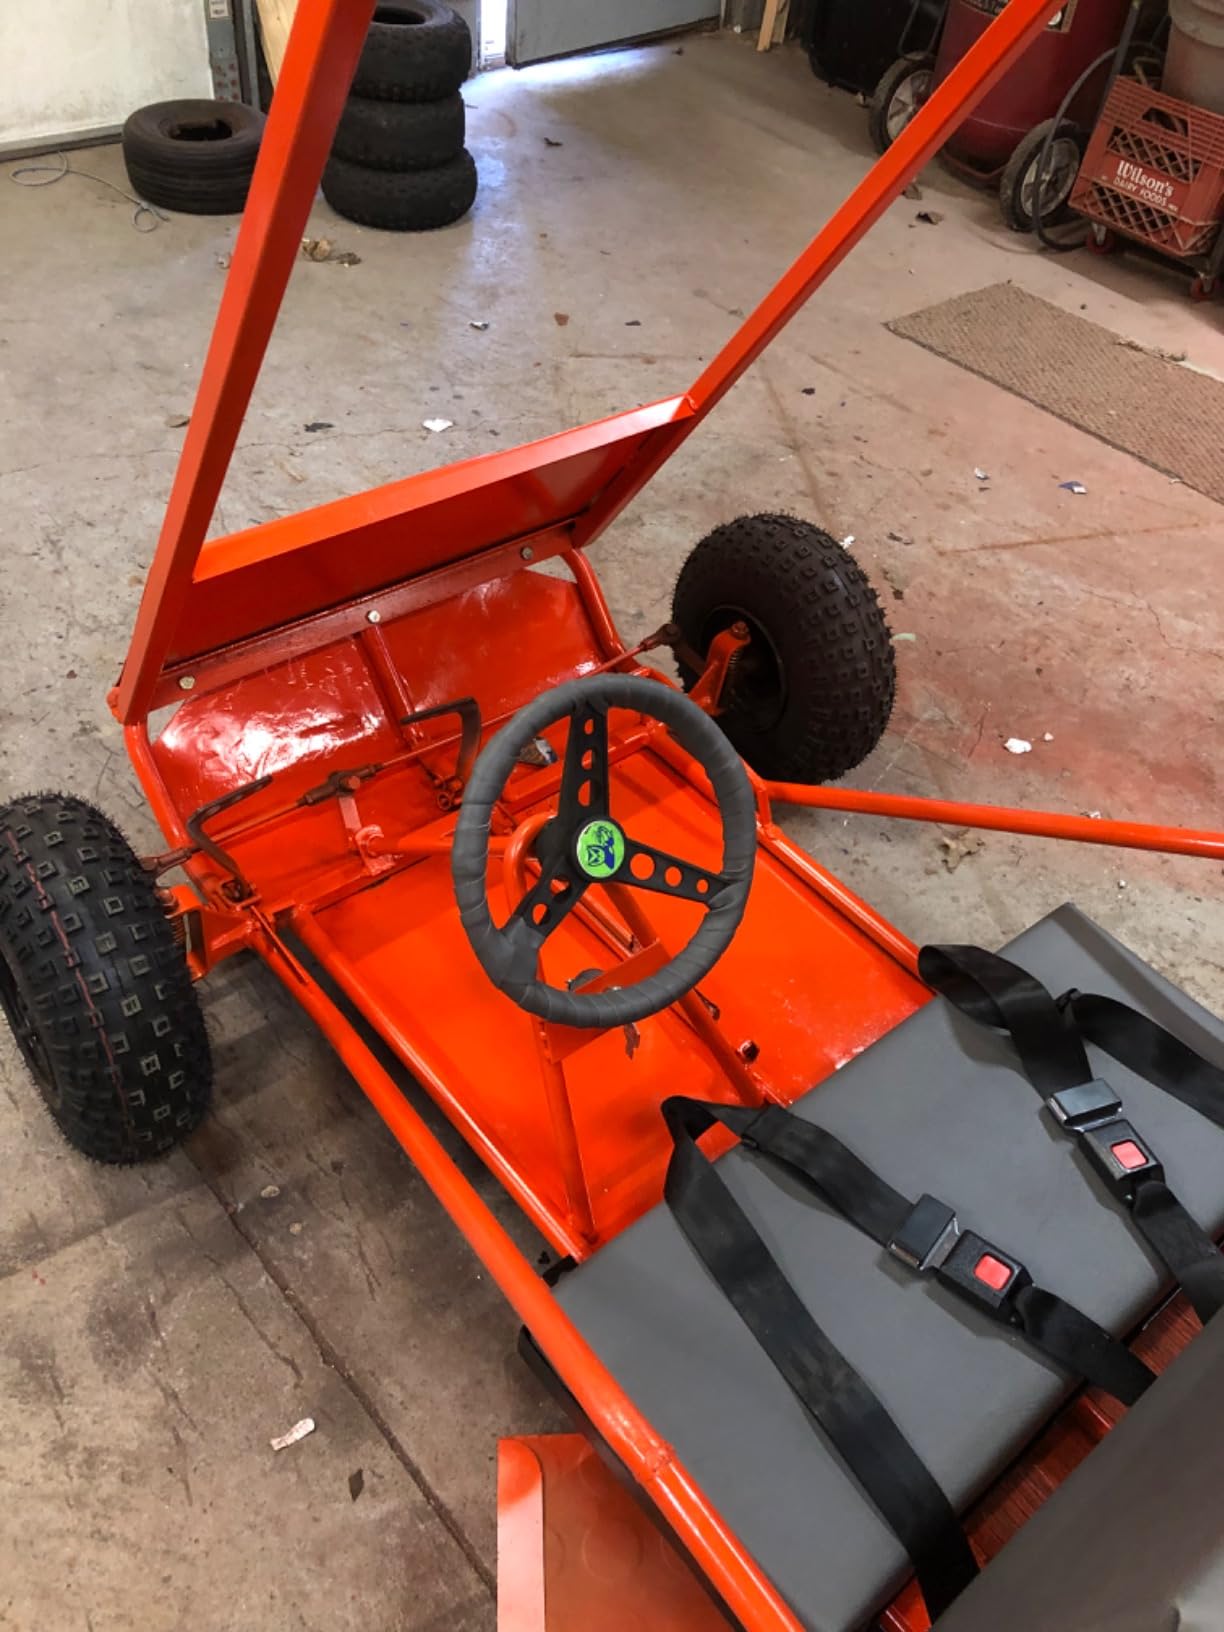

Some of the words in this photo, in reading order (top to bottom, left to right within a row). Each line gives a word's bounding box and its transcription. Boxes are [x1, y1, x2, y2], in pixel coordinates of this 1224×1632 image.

[1113, 176, 1137, 192] DAIRY
[1140, 189, 1167, 206] FOODS
[1117, 160, 1174, 197] Wilson's
